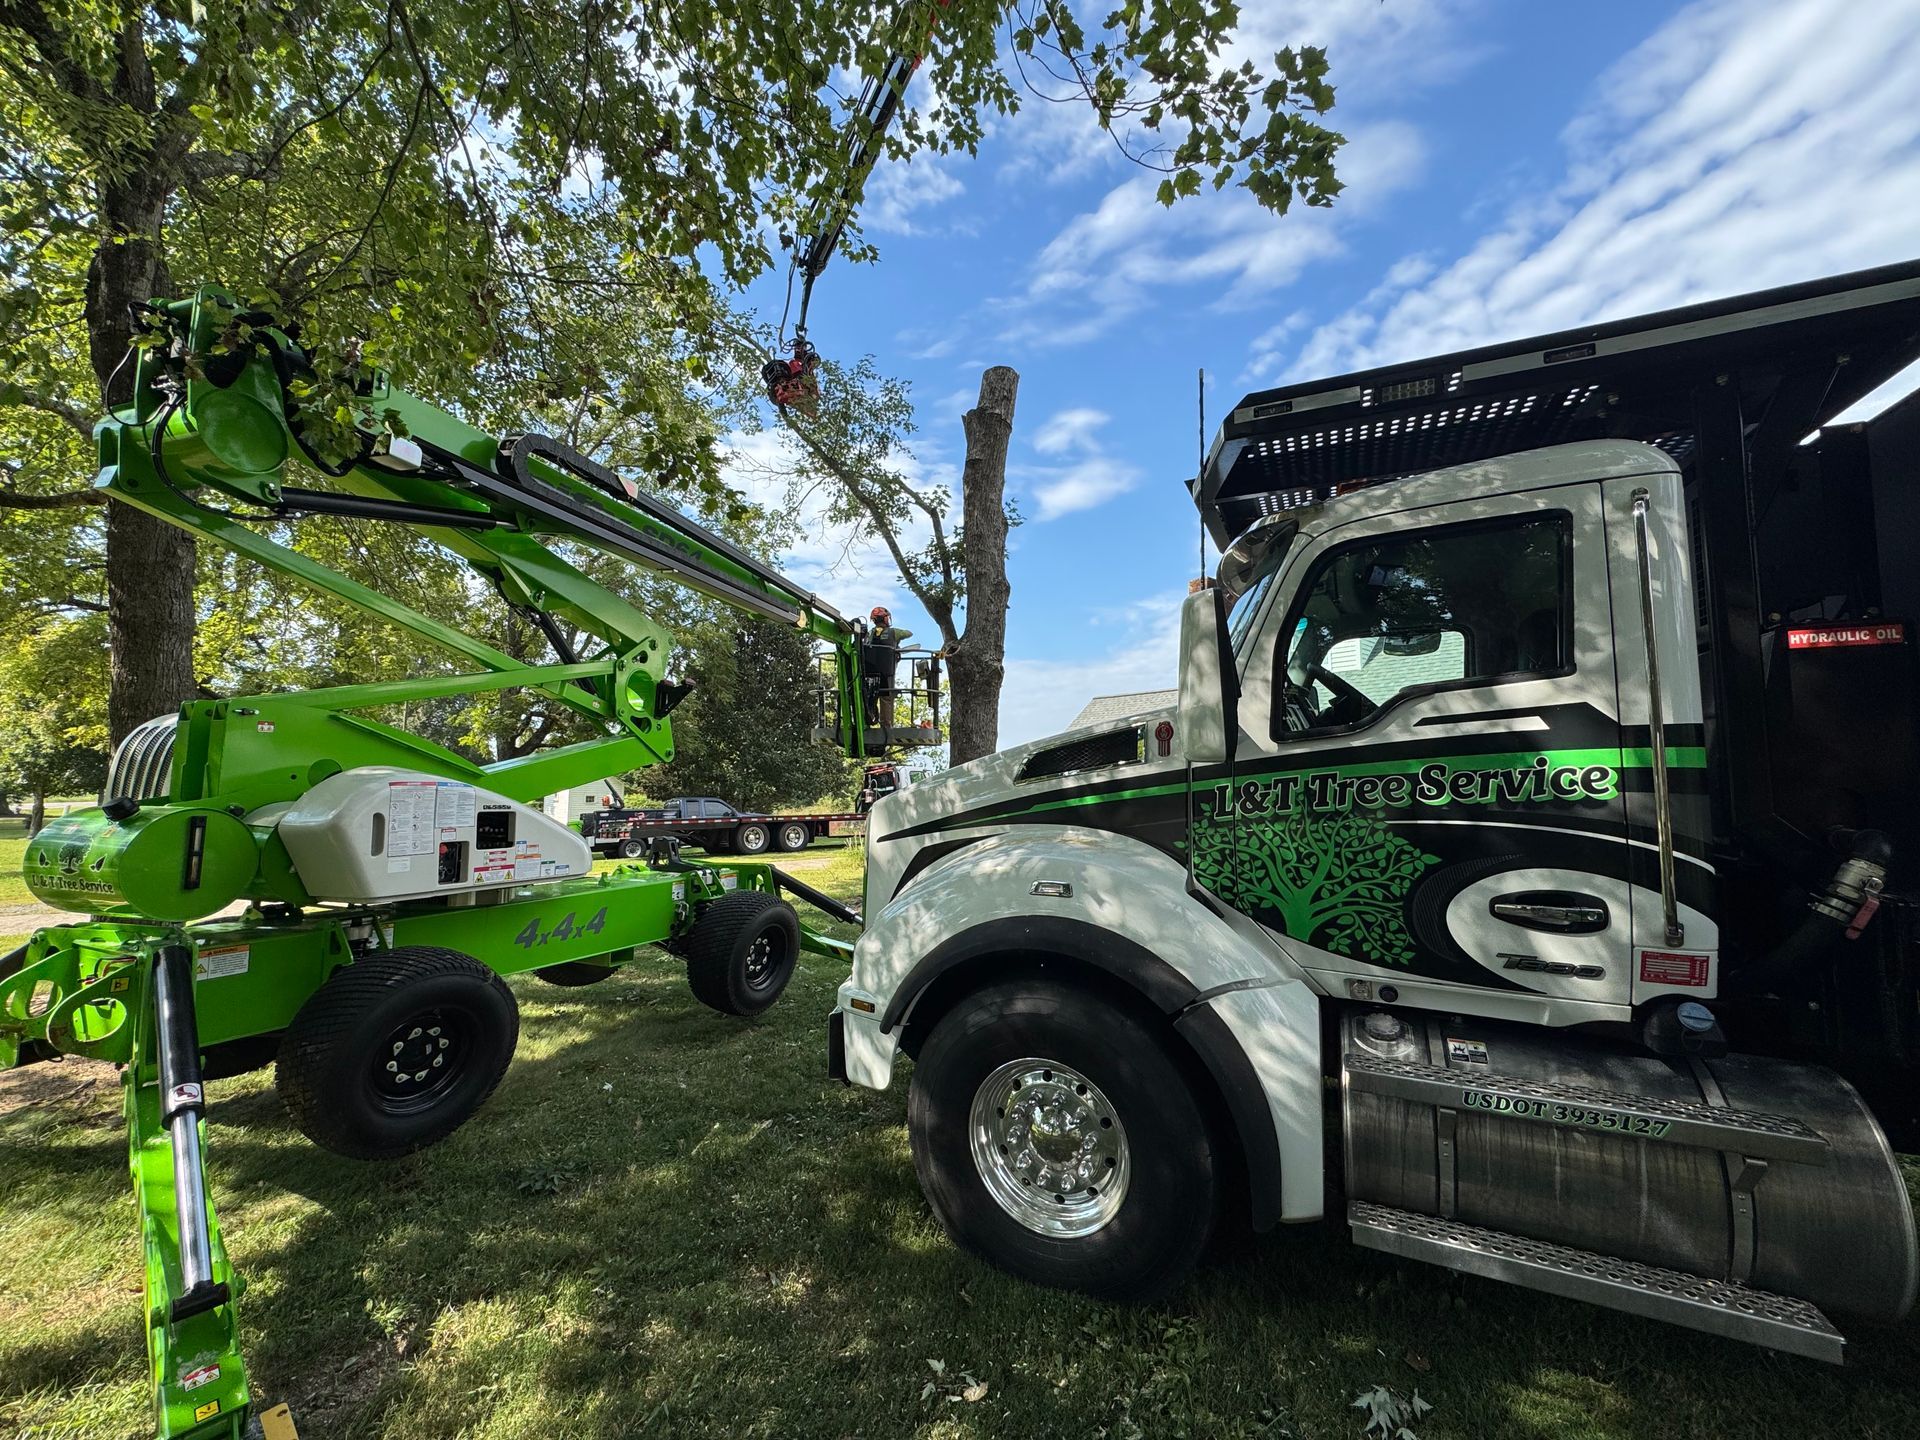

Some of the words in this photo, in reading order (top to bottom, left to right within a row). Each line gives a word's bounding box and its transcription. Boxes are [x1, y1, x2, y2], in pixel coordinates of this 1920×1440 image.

[1789, 631, 1870, 644] HYDRAULIC
[1876, 628, 1901, 640] OIL
[1214, 774, 1300, 822] L&T
[1308, 771, 1412, 810] Tree
[1416, 756, 1618, 806] Service
[57, 876, 79, 892] Tree
[79, 878, 115, 895] Service
[1463, 1091, 1547, 1117] USDOT
[1553, 1105, 1671, 1138] 3935127
